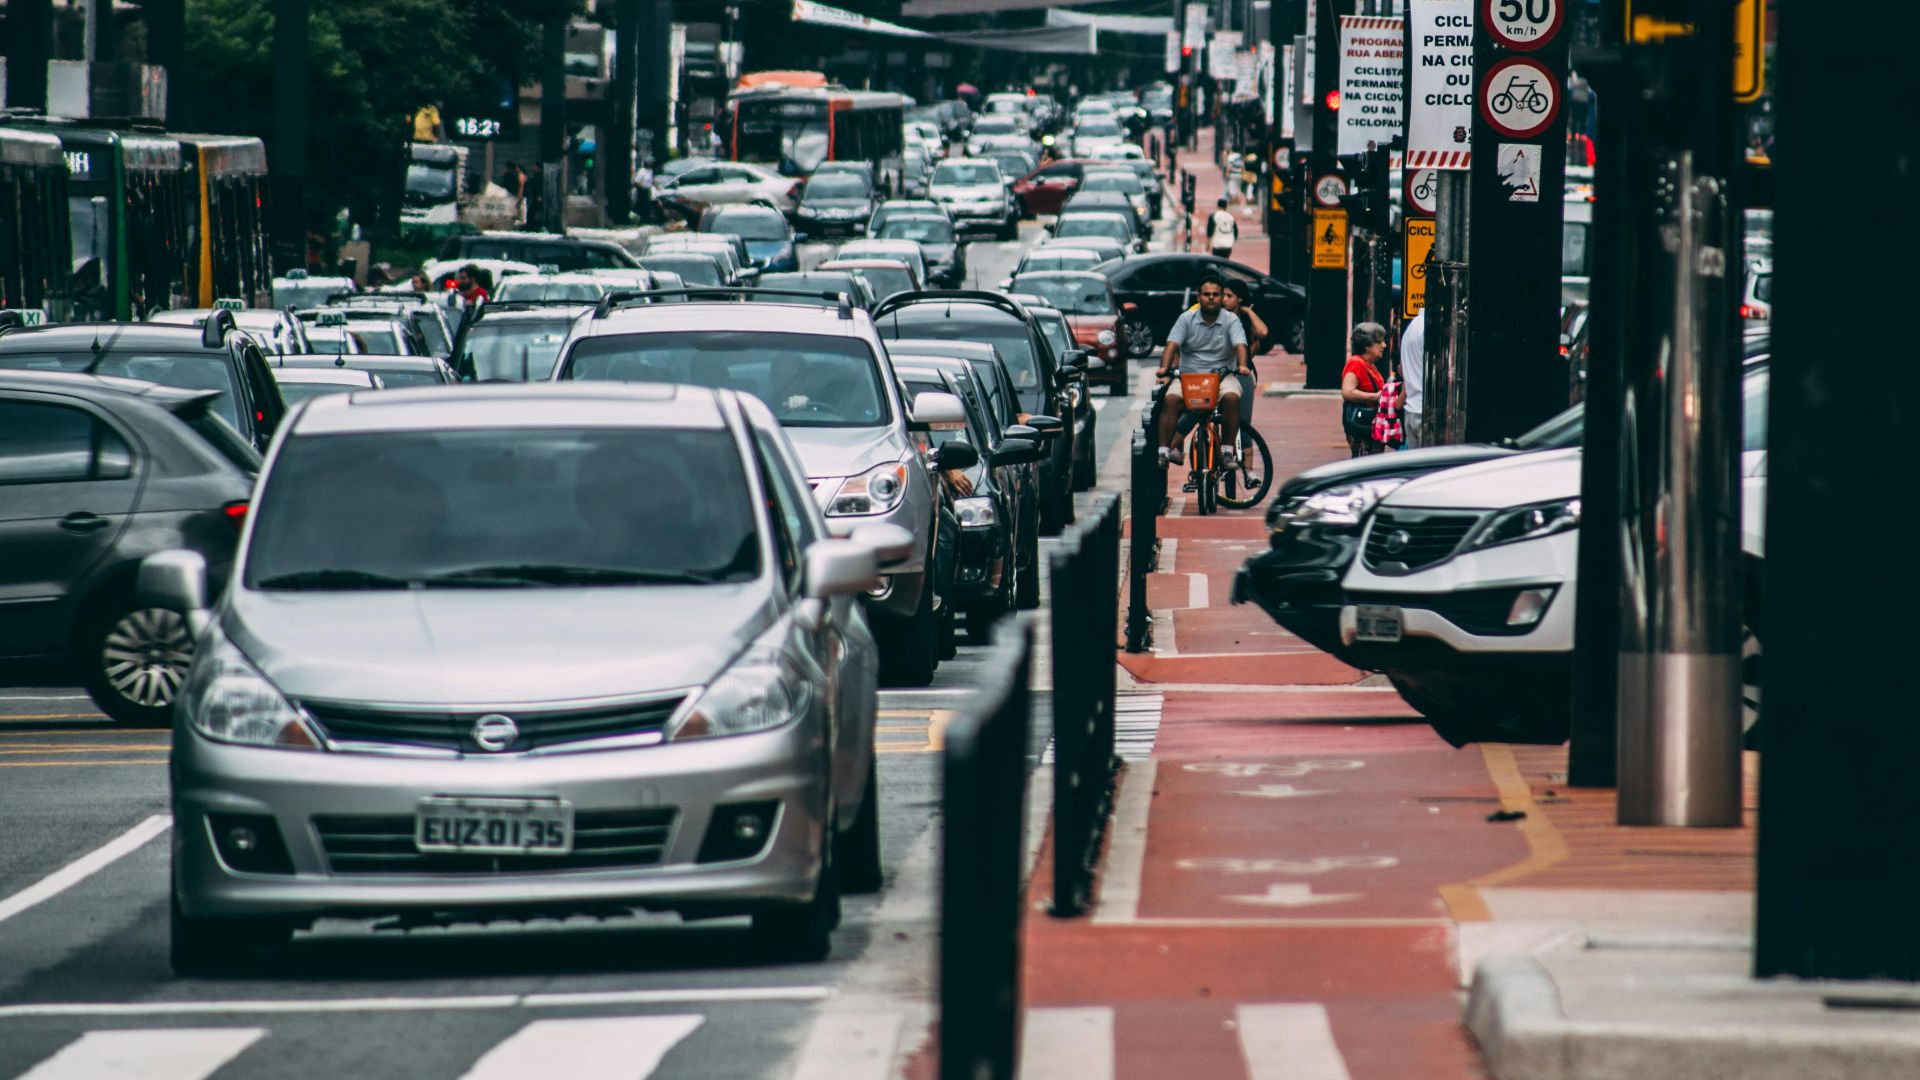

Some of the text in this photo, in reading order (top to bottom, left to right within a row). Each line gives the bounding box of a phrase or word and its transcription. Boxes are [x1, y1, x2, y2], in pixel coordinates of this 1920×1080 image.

[1499, 0, 1550, 24] 50
[1434, 15, 1473, 28] CICL
[1506, 26, 1537, 36] km/h
[1347, 49, 1371, 57] RUA
[1422, 55, 1446, 67] NA
[1446, 74, 1470, 86] OU
[1345, 92, 1362, 101] NA
[1361, 105, 1397, 115] OU NA
[456, 117, 500, 136] 15:21
[218, 301, 242, 311] TAXI
[322, 314, 342, 323] TAXI
